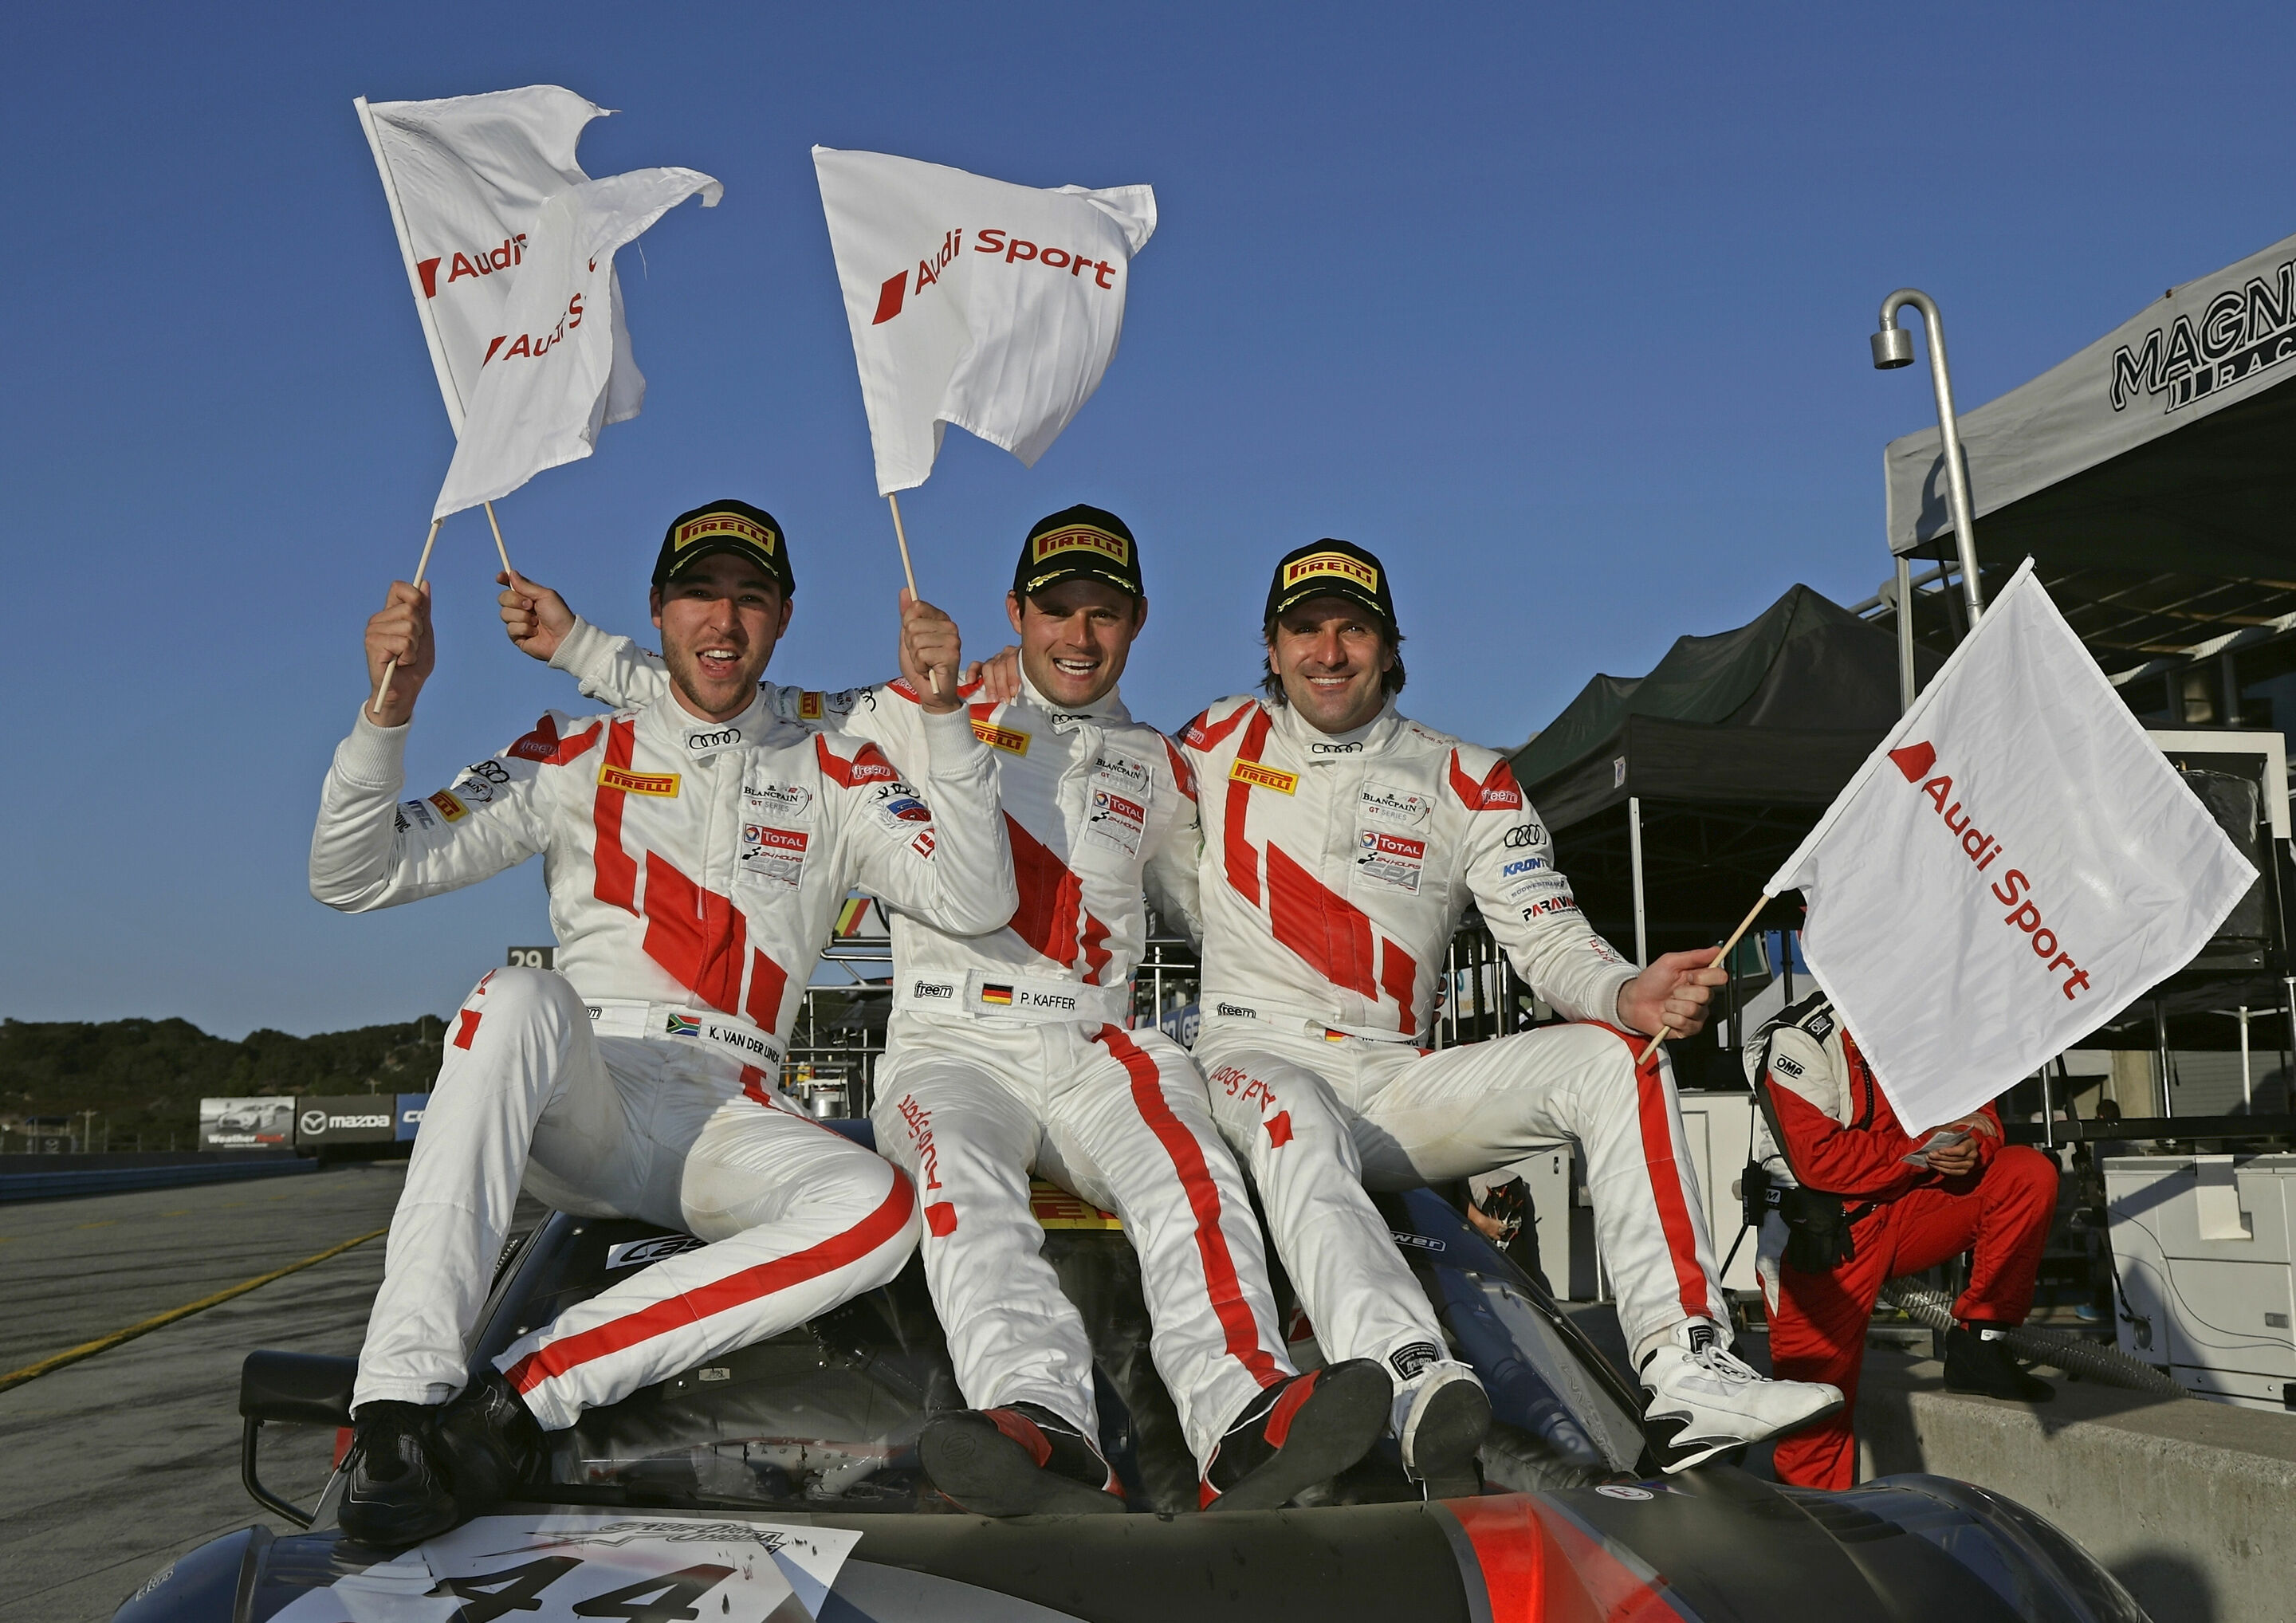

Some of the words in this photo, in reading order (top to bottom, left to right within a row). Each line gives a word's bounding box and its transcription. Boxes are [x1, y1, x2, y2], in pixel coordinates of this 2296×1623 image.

[448, 235, 521, 283] Audi
[915, 228, 962, 296] Audi
[974, 229, 1116, 290] Sport
[2110, 258, 2296, 412] MAGN
[680, 515, 769, 547] PIRELLI
[1038, 527, 1123, 558] PIRELLI
[1288, 556, 1372, 585] PIRELLI
[971, 724, 1024, 750] RELLI
[1095, 758, 1141, 780] BLANCPAIN
[1235, 764, 1293, 791] PIRELLI
[603, 769, 674, 793] PIRELLI
[744, 786, 798, 802] BLANCPAIN
[1362, 792, 1417, 812] BLANCPAIN
[765, 800, 789, 812] SERIES
[1111, 798, 1142, 819] TOTAL
[1381, 809, 1407, 821] SERIES
[763, 831, 804, 847] TOTAL
[1380, 838, 1421, 855] TOTAL
[1921, 776, 2003, 872] Audi
[1991, 869, 2091, 1001] Sport
[511, 950, 542, 969] 29
[914, 980, 955, 999] freem
[1020, 992, 1030, 1004] P.
[1033, 993, 1075, 1010] KAFFER
[1217, 1002, 1256, 1019] freem
[709, 1026, 719, 1040] K.
[723, 1029, 745, 1047] VAN
[746, 1037, 764, 1055] DER
[1776, 1057, 1803, 1076] OMP
